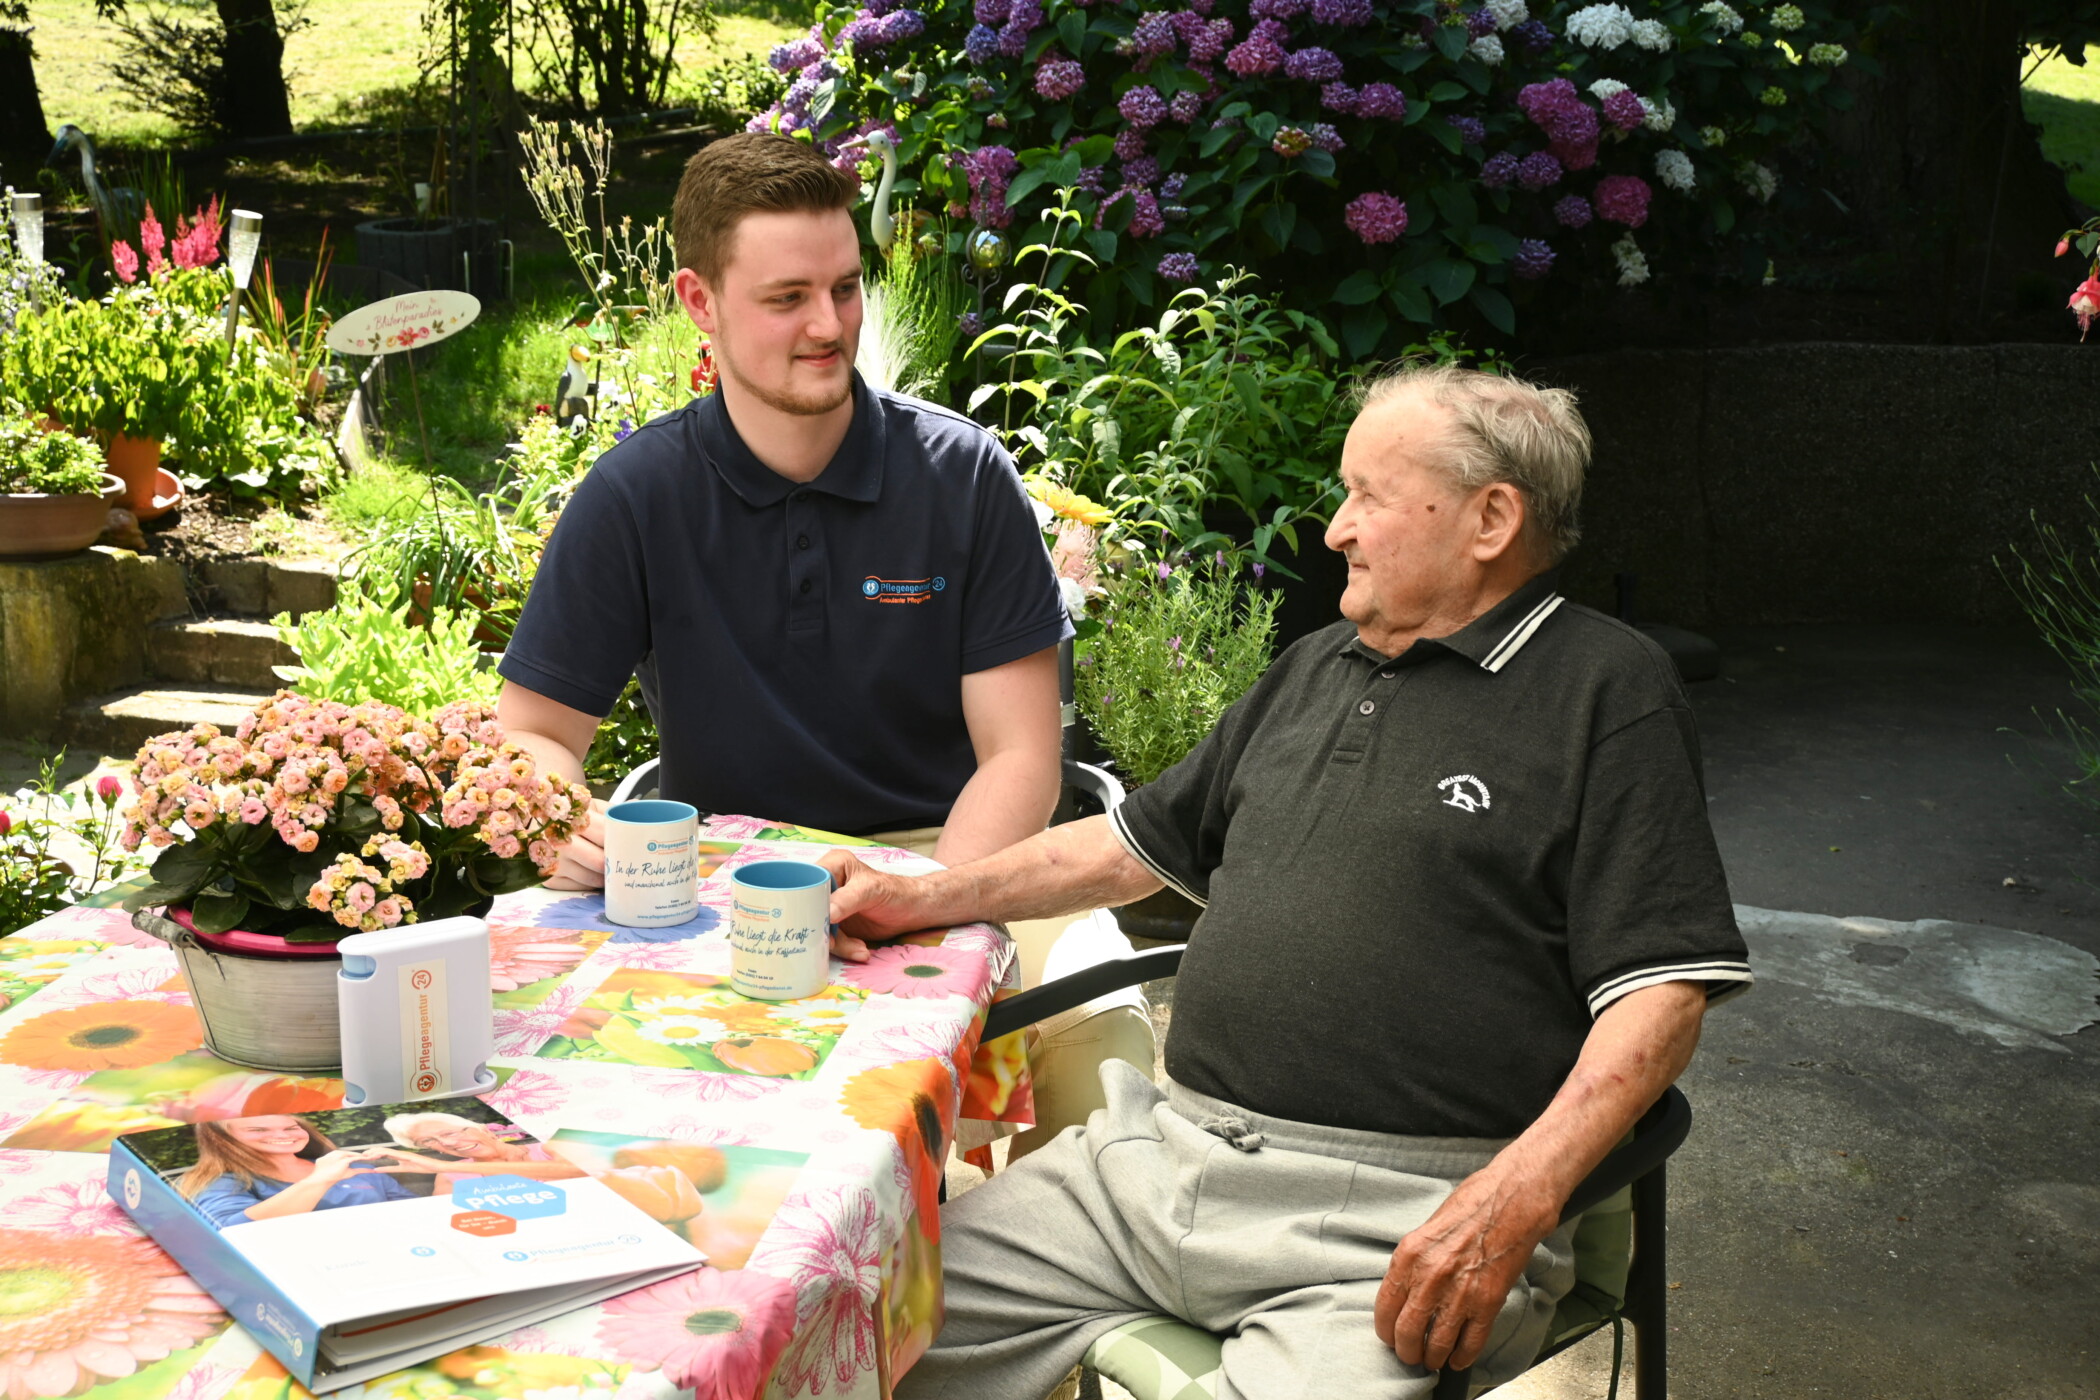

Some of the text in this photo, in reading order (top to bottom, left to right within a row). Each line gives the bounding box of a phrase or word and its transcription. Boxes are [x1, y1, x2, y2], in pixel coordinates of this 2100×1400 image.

[395, 300, 419, 313] Mein
[1437, 774, 1470, 790] GREATEST
[625, 862, 639, 877] der
[641, 862, 666, 876] Ruhe
[668, 860, 685, 877] liegt
[746, 926, 766, 947] liegt
[768, 928, 781, 944] die
[784, 928, 809, 944] Kraft
[419, 994, 432, 1071] Pflegeagentur
[465, 1190, 558, 1210] Pflege
